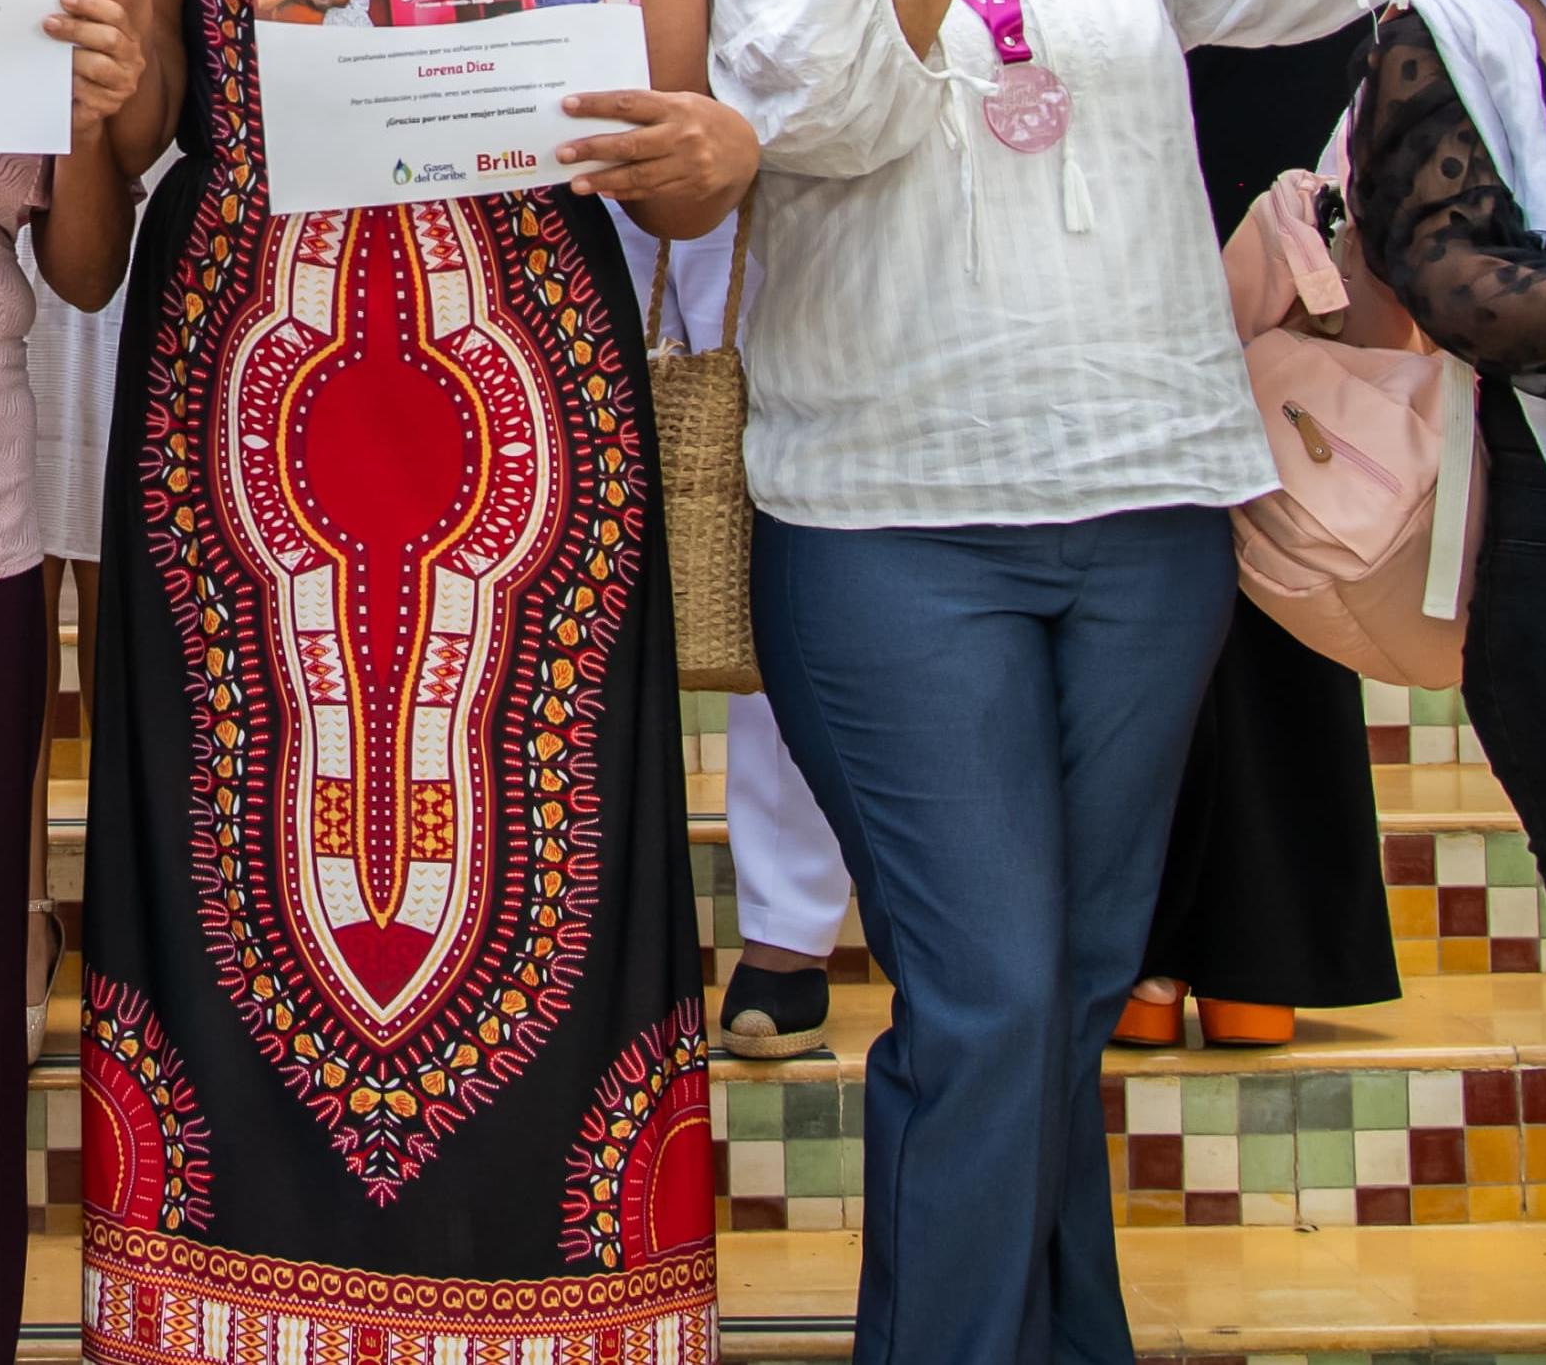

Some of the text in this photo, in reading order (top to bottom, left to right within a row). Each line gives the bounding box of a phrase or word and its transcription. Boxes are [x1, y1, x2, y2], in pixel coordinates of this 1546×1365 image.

[418, 63, 463, 78] Lorena
[424, 163, 454, 172] Gases
[477, 150, 537, 172] Brilla
[415, 171, 466, 183] del Caribe
